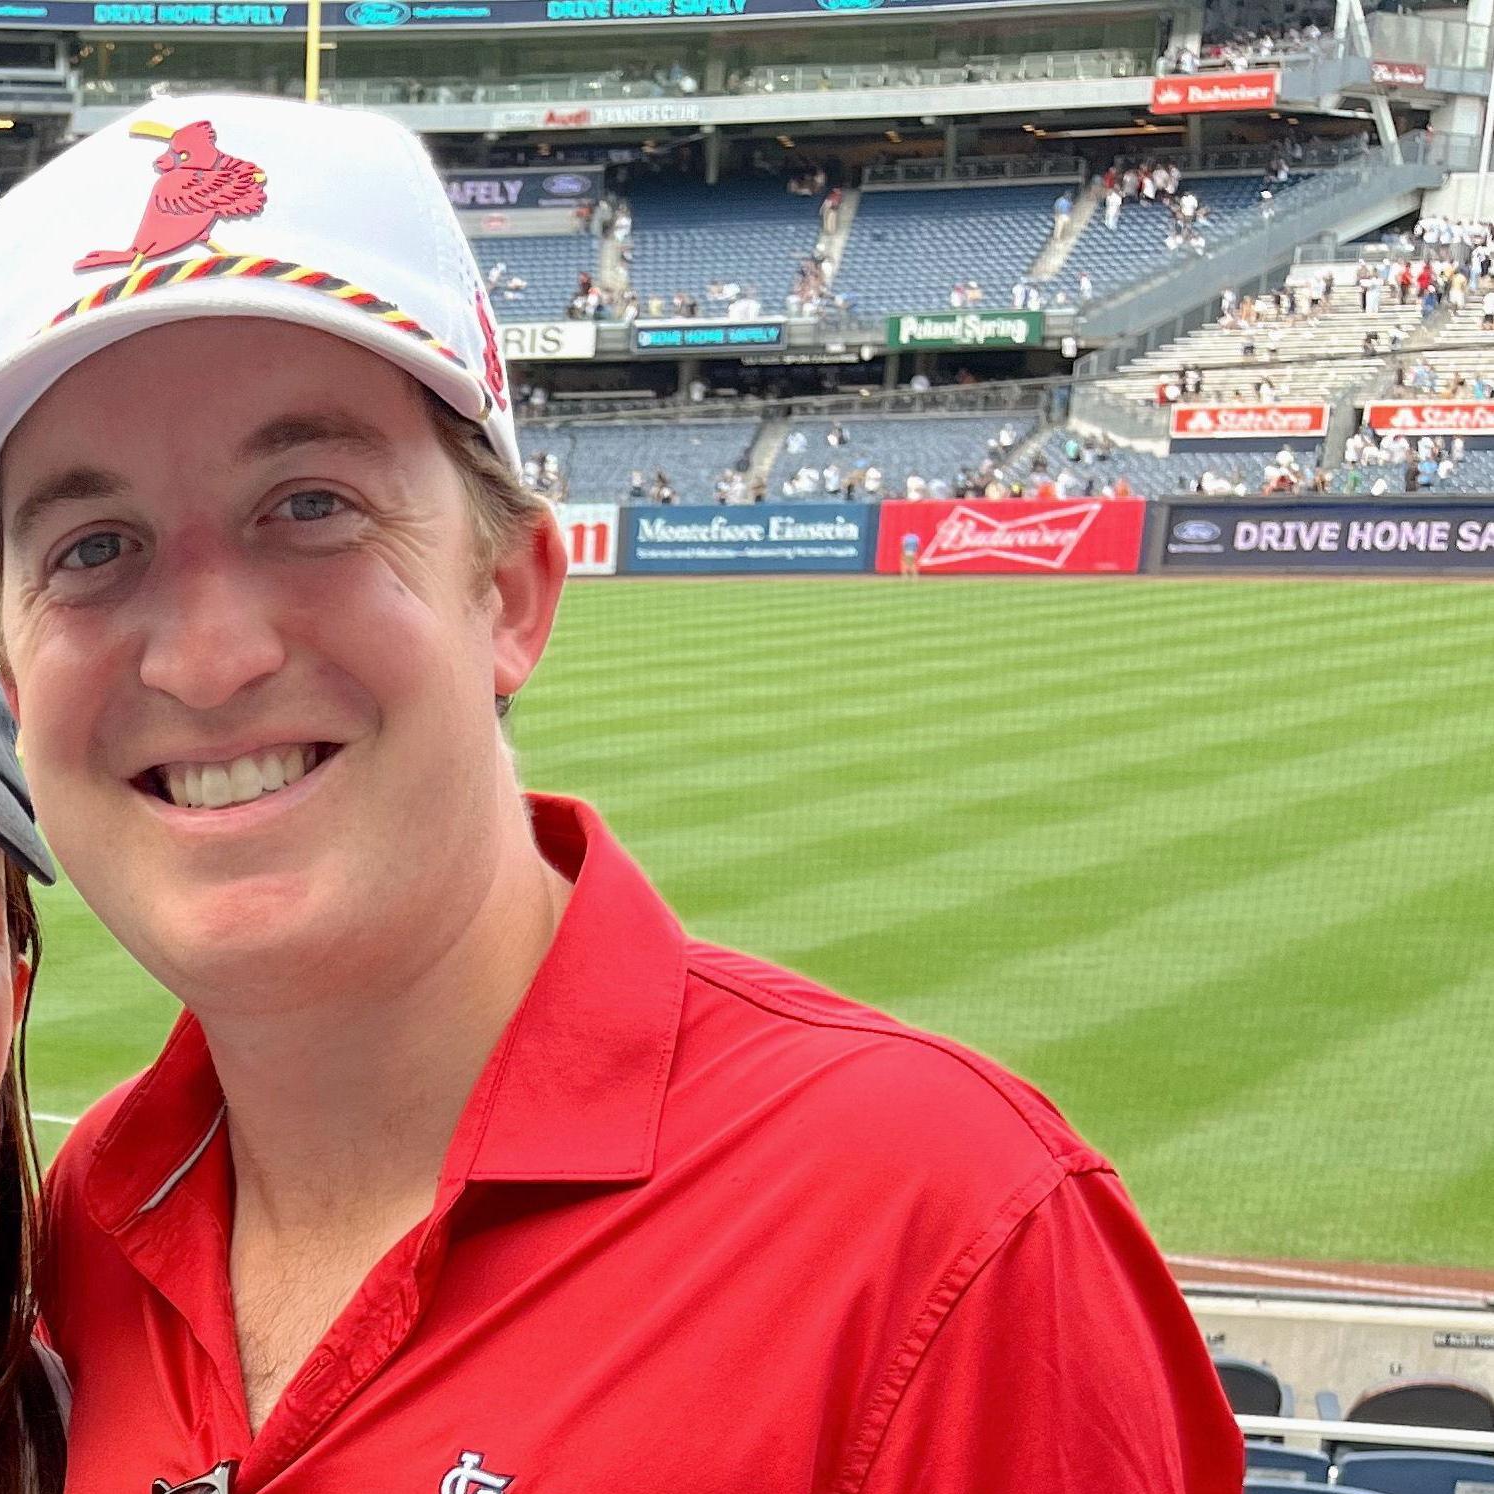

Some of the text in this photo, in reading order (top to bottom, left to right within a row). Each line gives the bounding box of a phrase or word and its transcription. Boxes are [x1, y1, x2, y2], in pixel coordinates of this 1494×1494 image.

[94, 4, 288, 25] DRIVE HOME SAFELY
[548, 0, 611, 19] DRIVE
[1188, 86, 1269, 103] Budweiser
[545, 108, 590, 126] Audi
[447, 180, 524, 205] AFELY
[898, 315, 1028, 344] Poland Spring
[638, 516, 859, 543] Montefiore Einstein
[937, 520, 1079, 549] Budweiser
[1233, 521, 1341, 552] DRIVE
[1347, 521, 1451, 552] HOME
